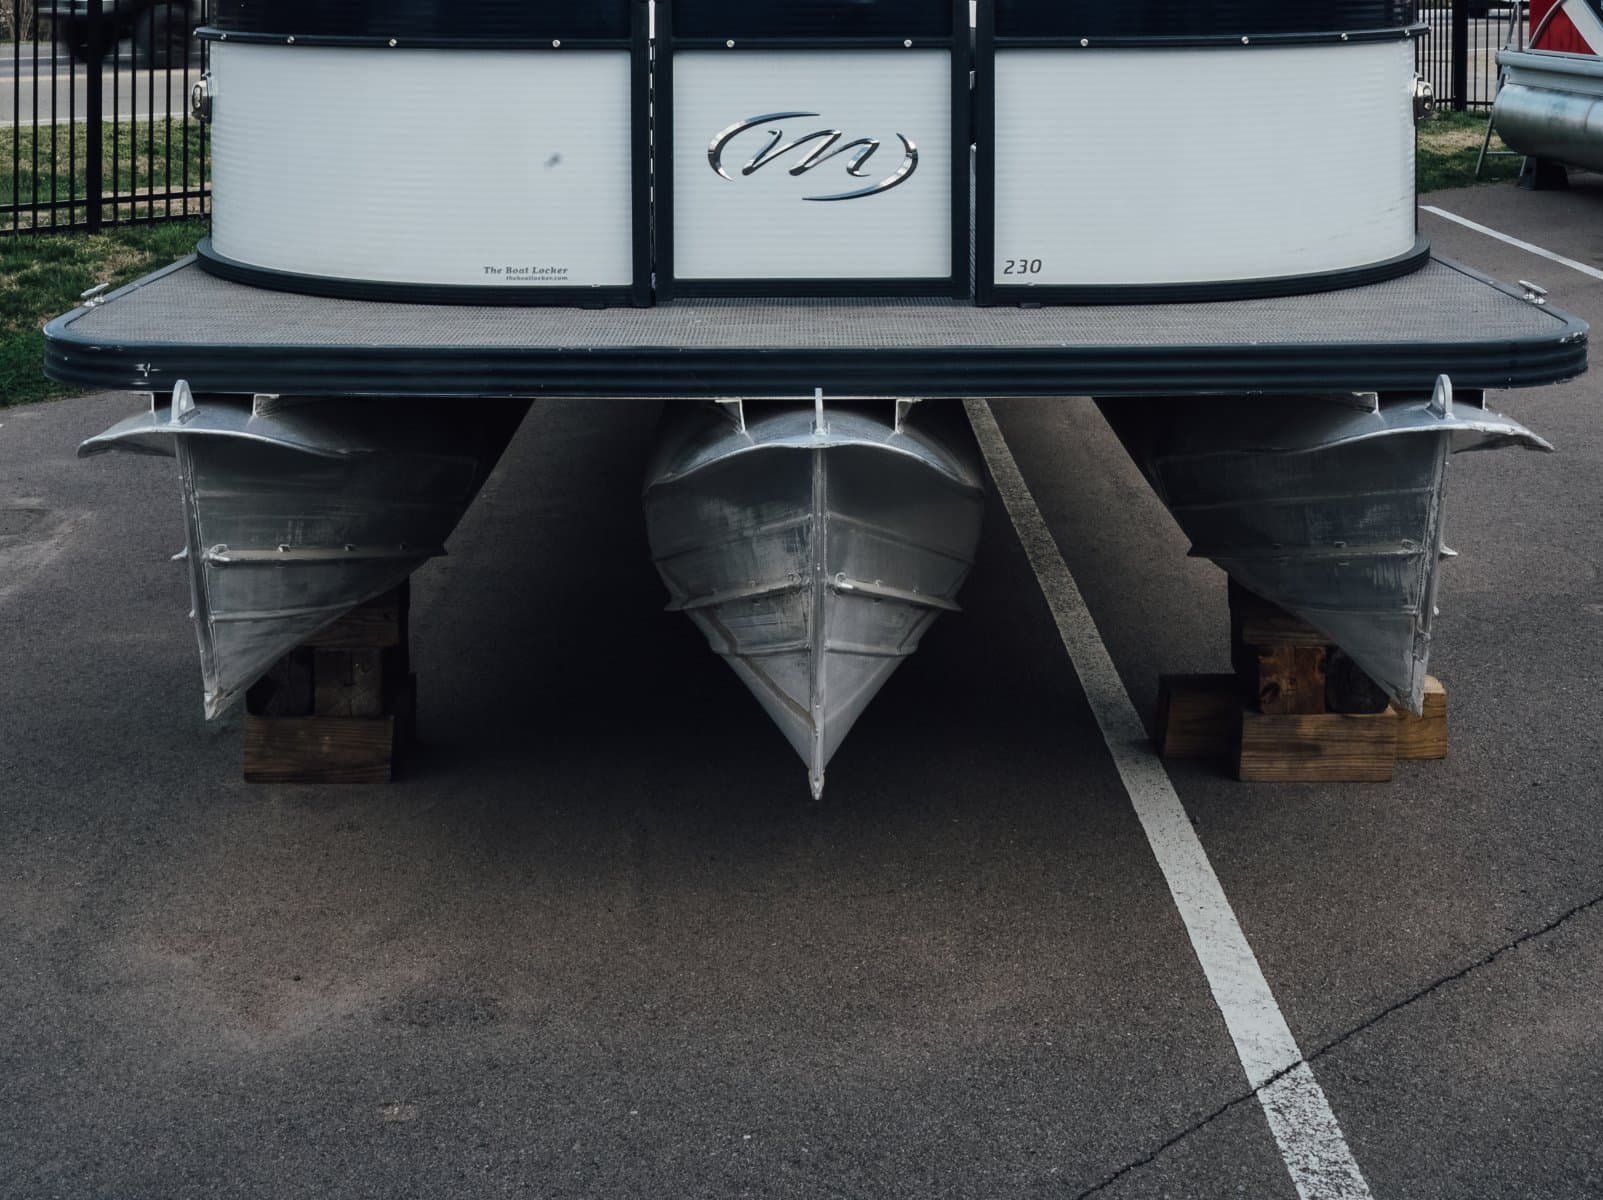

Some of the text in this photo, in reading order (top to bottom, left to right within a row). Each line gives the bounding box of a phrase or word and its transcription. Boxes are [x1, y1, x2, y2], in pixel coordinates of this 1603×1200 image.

[484, 266, 569, 274] The Boat Locker
[1003, 259, 1042, 274] 230
